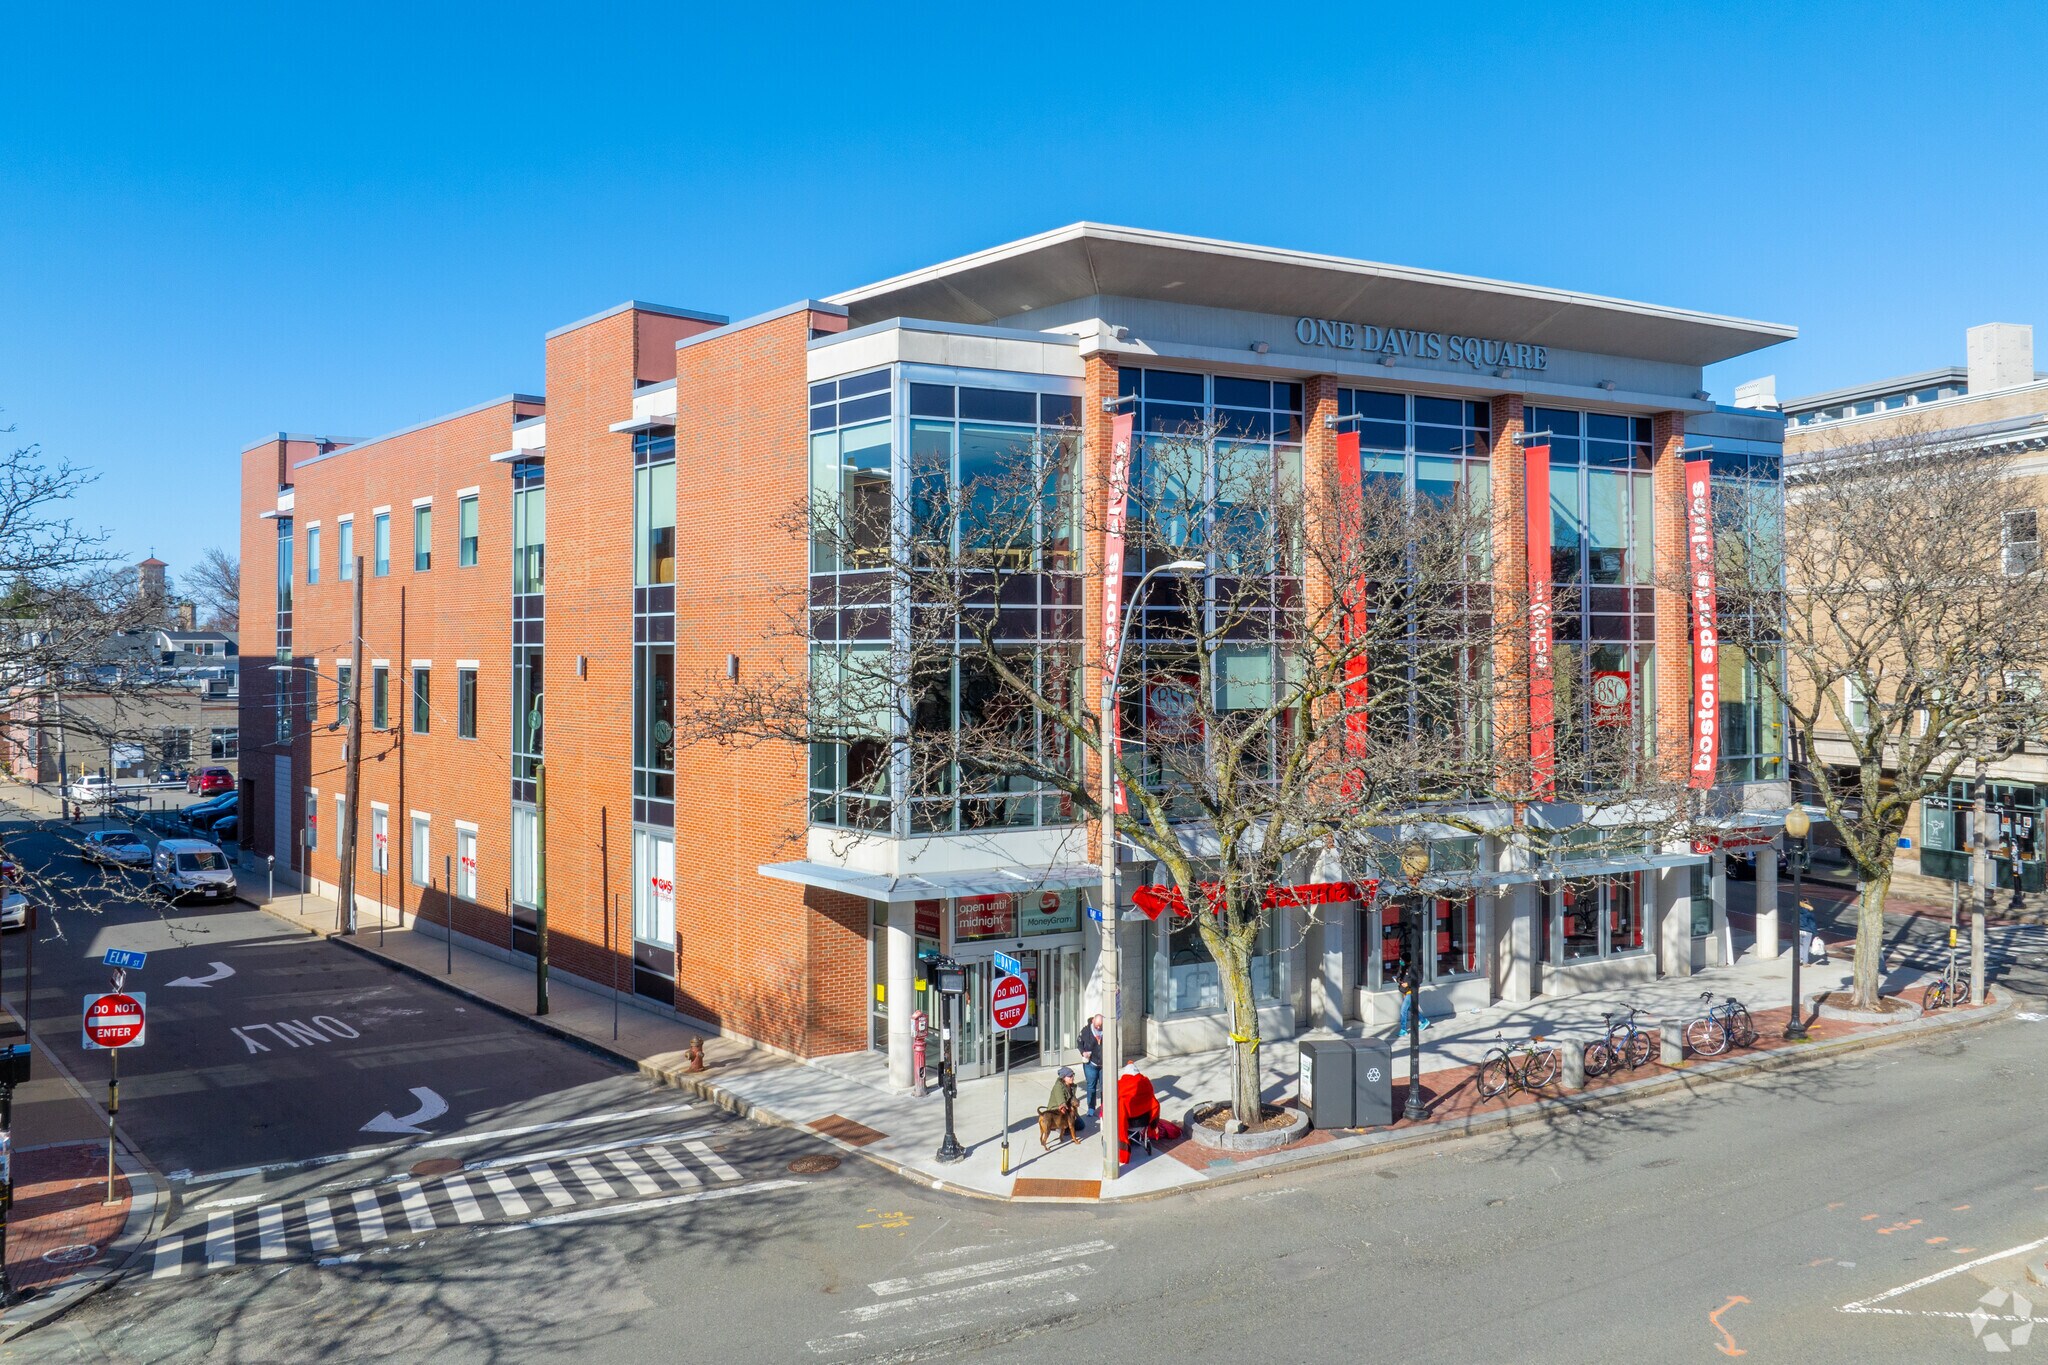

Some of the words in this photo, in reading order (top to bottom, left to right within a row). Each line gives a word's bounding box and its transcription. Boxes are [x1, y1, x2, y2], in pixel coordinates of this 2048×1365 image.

[1297, 317, 1355, 350] ONE
[1362, 325, 1442, 359] DAVIS
[1449, 335, 1548, 371] SQUARE
[1690, 480, 1709, 561] clubs
[1695, 571, 1716, 664] sports
[1598, 679, 1623, 703] BSC
[1694, 673, 1715, 772] boston
[959, 903, 985, 914] open
[987, 899, 1007, 911] until
[959, 914, 1003, 928] midnight
[109, 951, 131, 965] ELM
[997, 988, 1007, 998] DO
[1009, 984, 1023, 995] NOT
[94, 1005, 109, 1014] DO
[114, 1003, 136, 1013] NOT
[1000, 1007, 1021, 1020] ENTER
[97, 1027, 131, 1038] ENTER
[230, 1015, 361, 1054] ONLY
